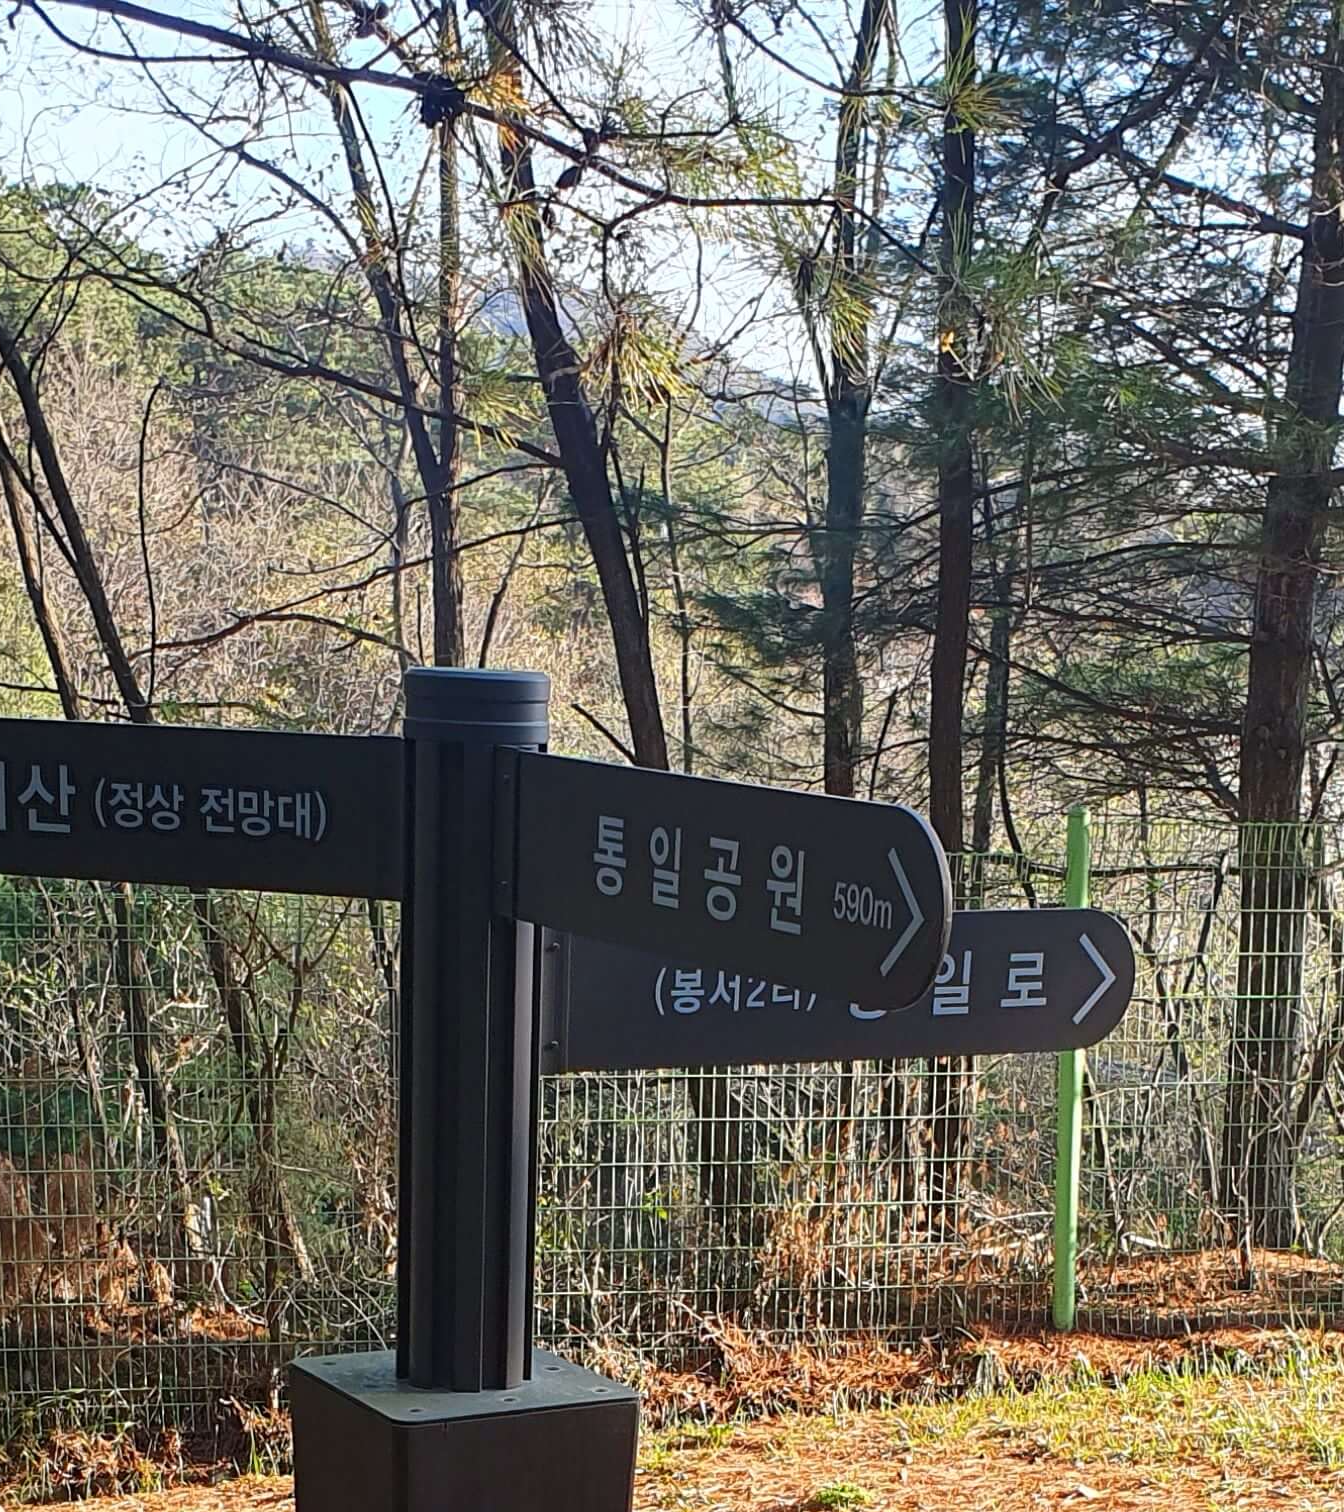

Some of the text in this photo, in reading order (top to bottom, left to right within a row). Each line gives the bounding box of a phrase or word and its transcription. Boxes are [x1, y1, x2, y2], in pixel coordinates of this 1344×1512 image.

[94, 777, 182, 832] (정상
[199, 784, 327, 842] 전망대)
[593, 814, 894, 936] 통일공원 590m
